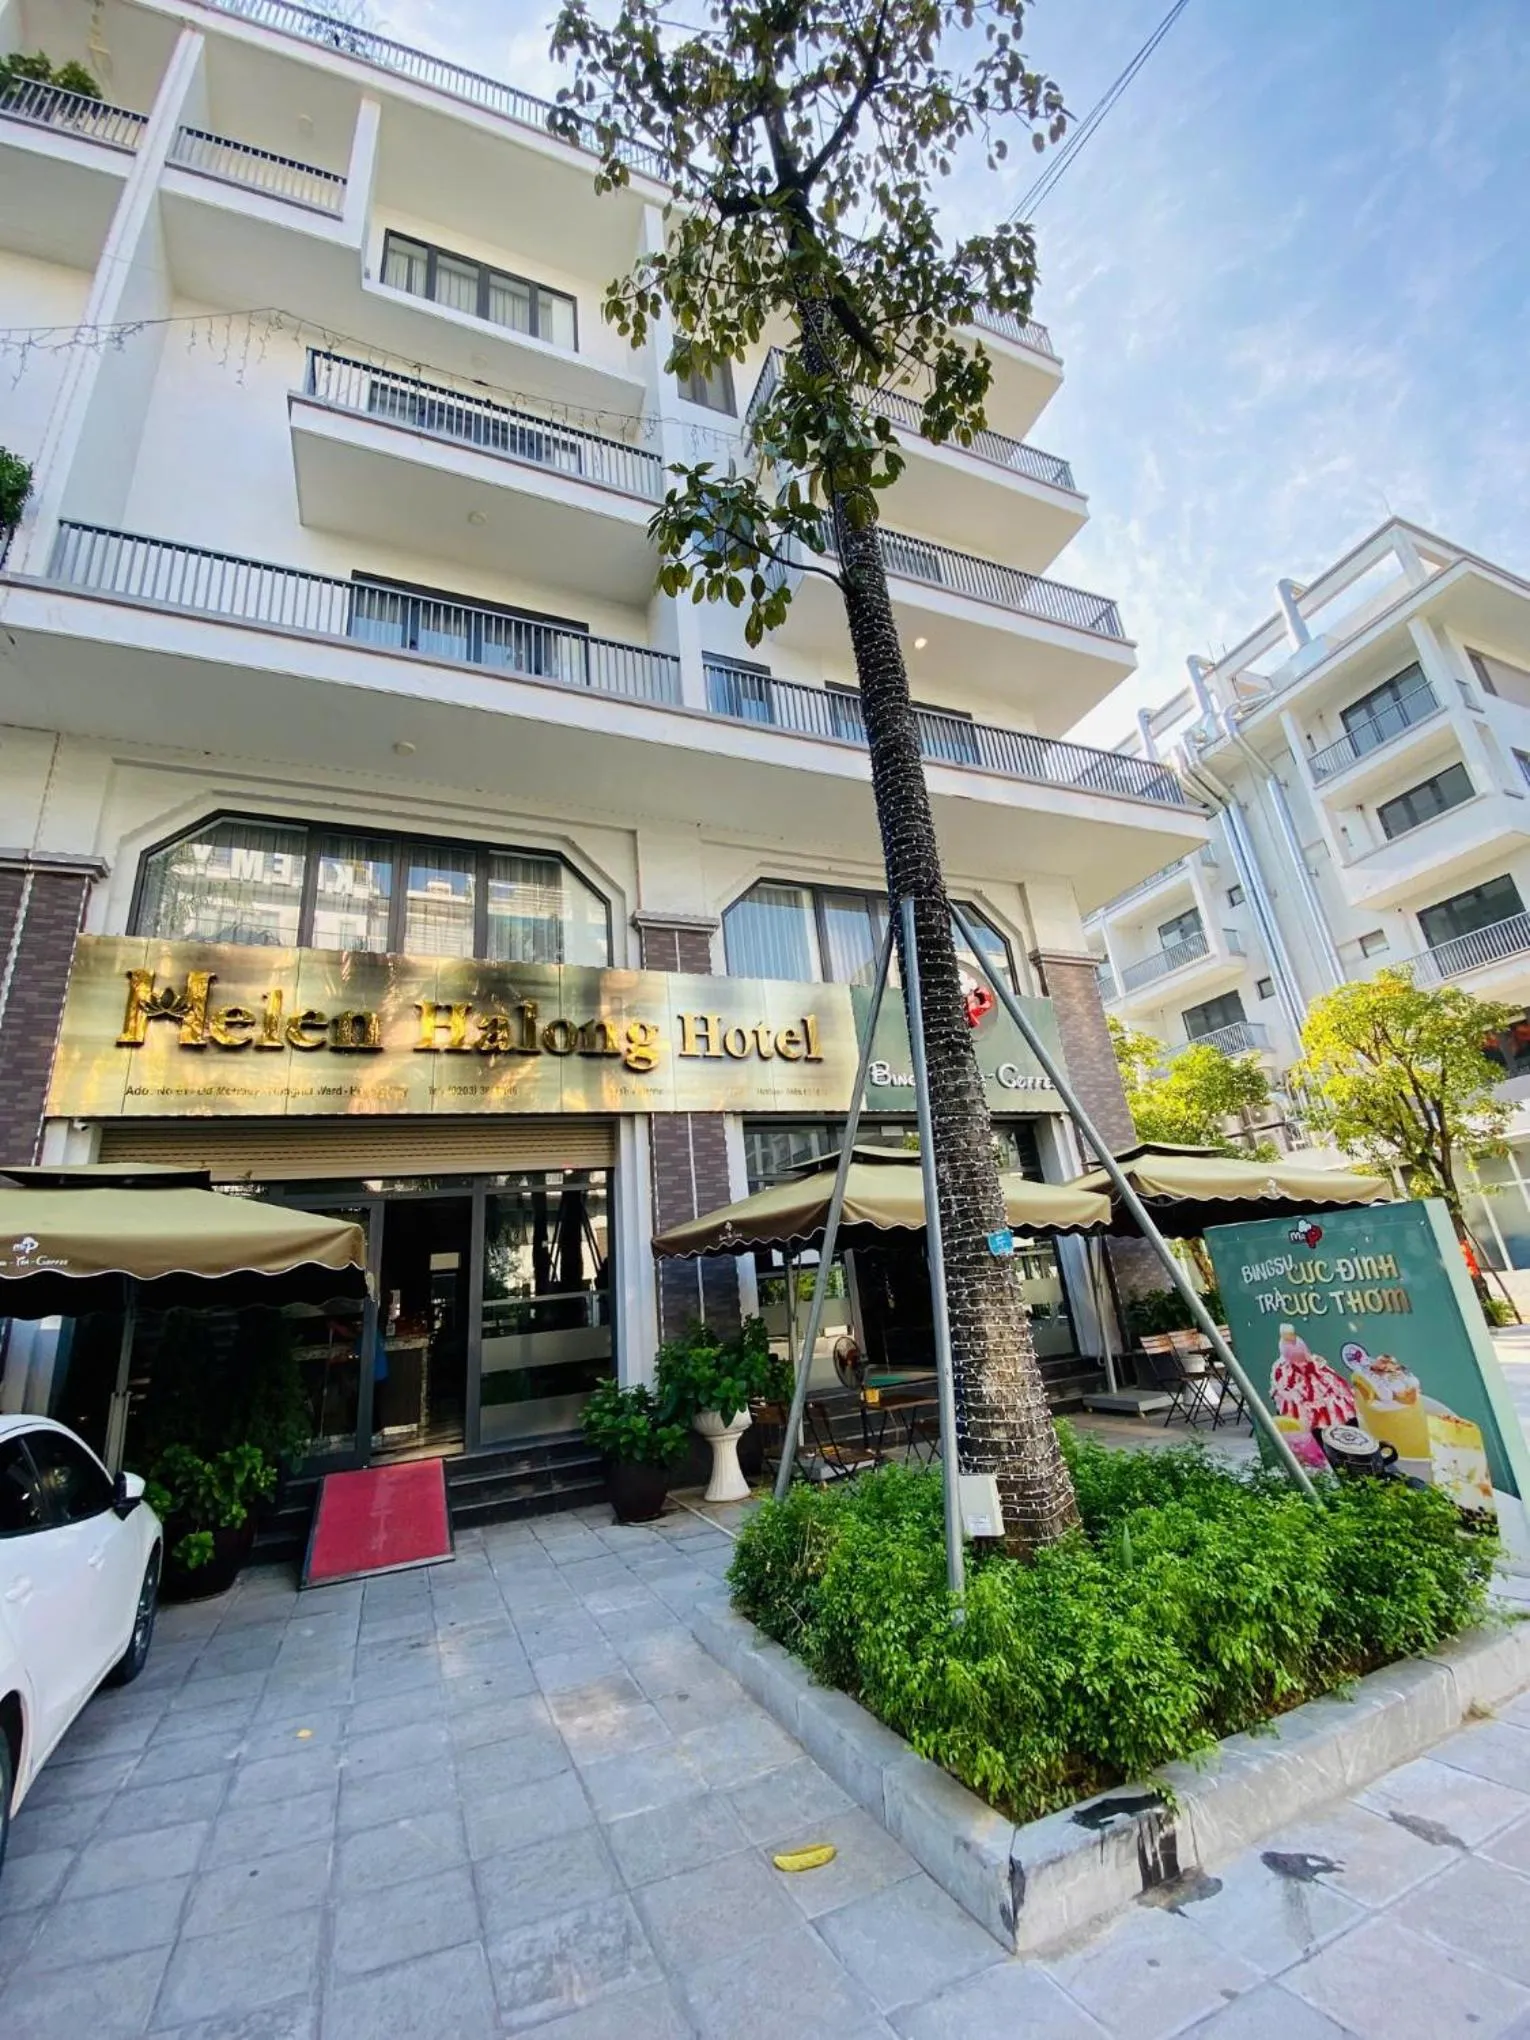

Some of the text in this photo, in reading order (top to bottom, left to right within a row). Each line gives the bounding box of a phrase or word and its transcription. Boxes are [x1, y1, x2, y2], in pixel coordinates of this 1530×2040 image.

[115, 968, 825, 1073] Helen Halong Hotel
[1241, 1254, 1293, 1284] BINGSU
[1255, 1287, 1286, 1314] TRÀ
[1281, 1291, 1328, 1321] CỰC
